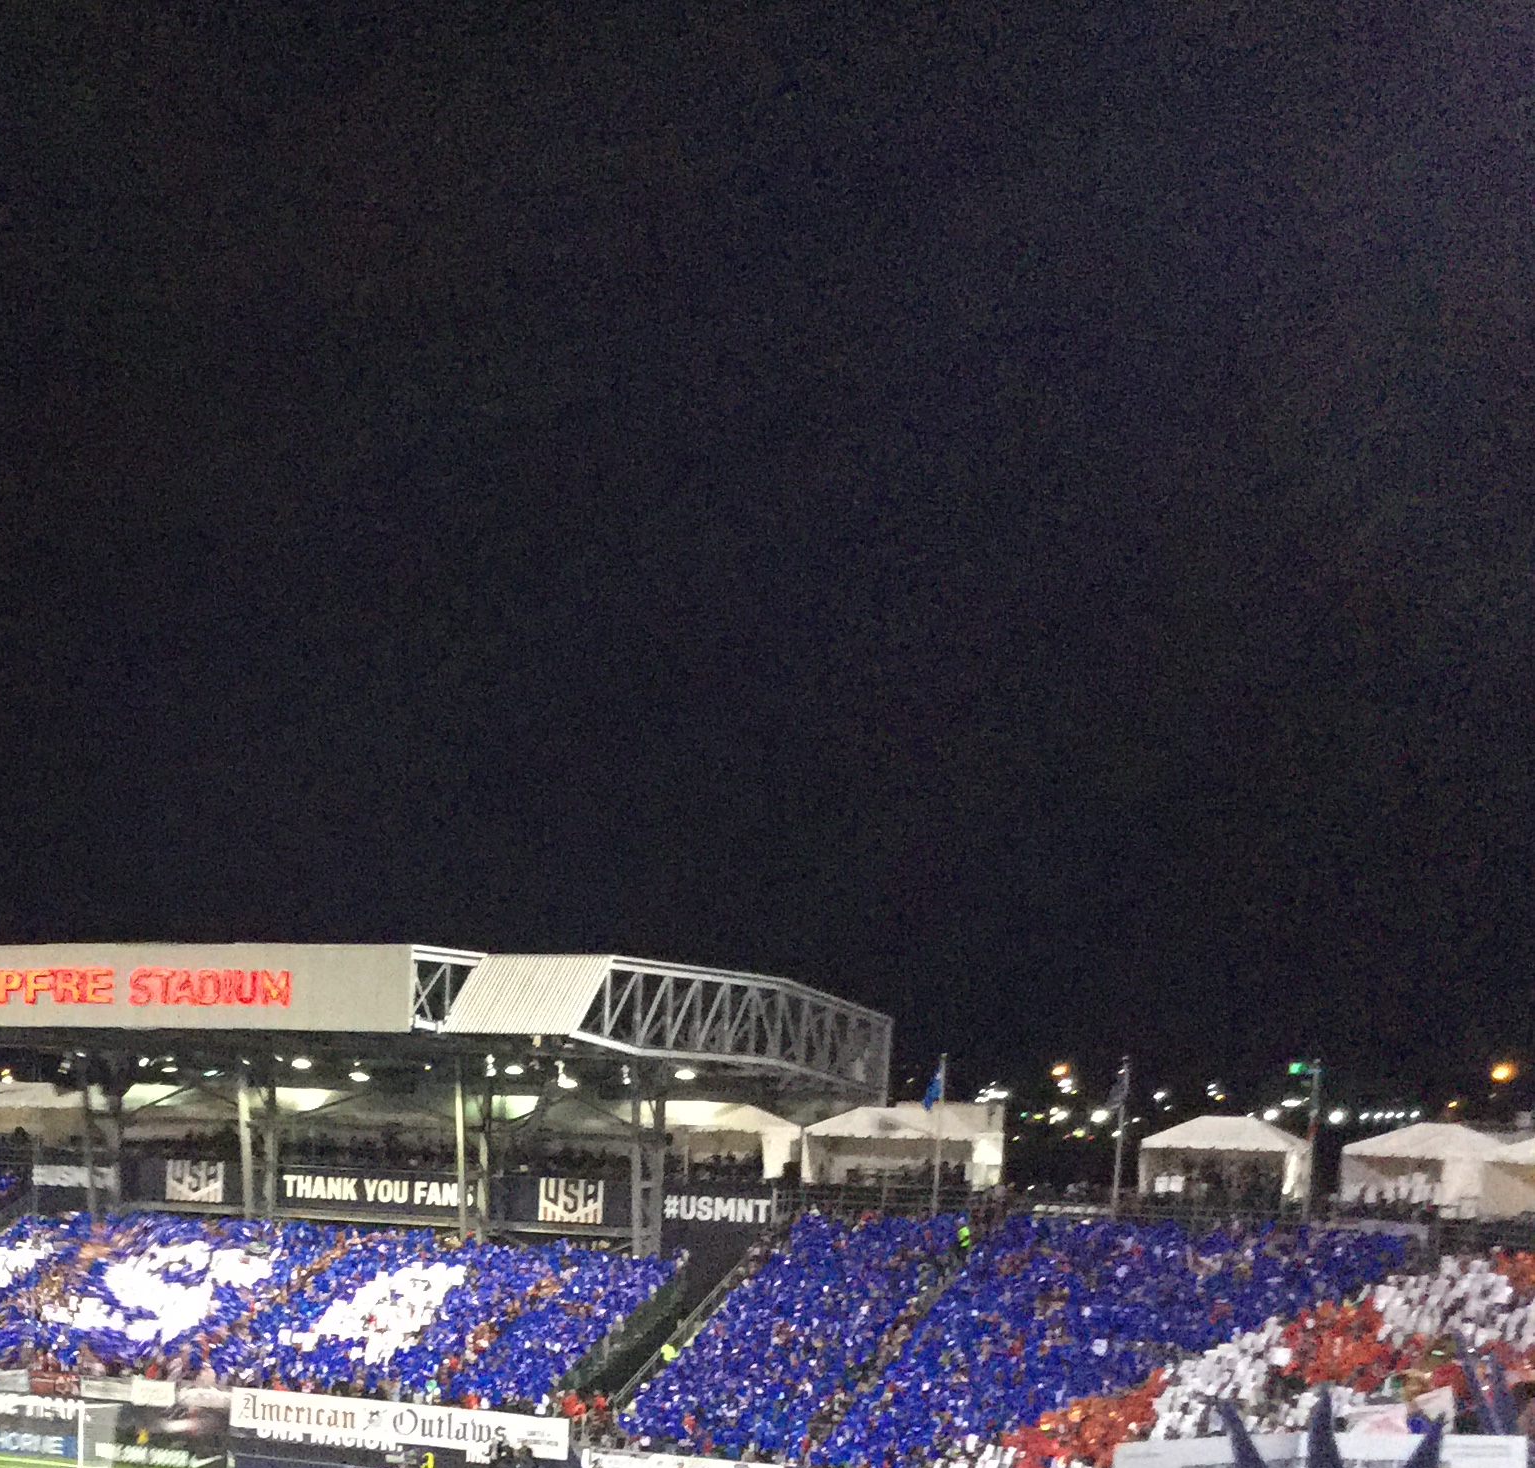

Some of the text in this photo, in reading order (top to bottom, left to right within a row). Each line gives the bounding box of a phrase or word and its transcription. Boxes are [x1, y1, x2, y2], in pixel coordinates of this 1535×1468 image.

[283, 1175, 358, 1203] THANK
[364, 1178, 408, 1205] YOU
[664, 1195, 772, 1225] #USMNT
[238, 1392, 356, 1431] American
[393, 1408, 508, 1447] Outlaws
